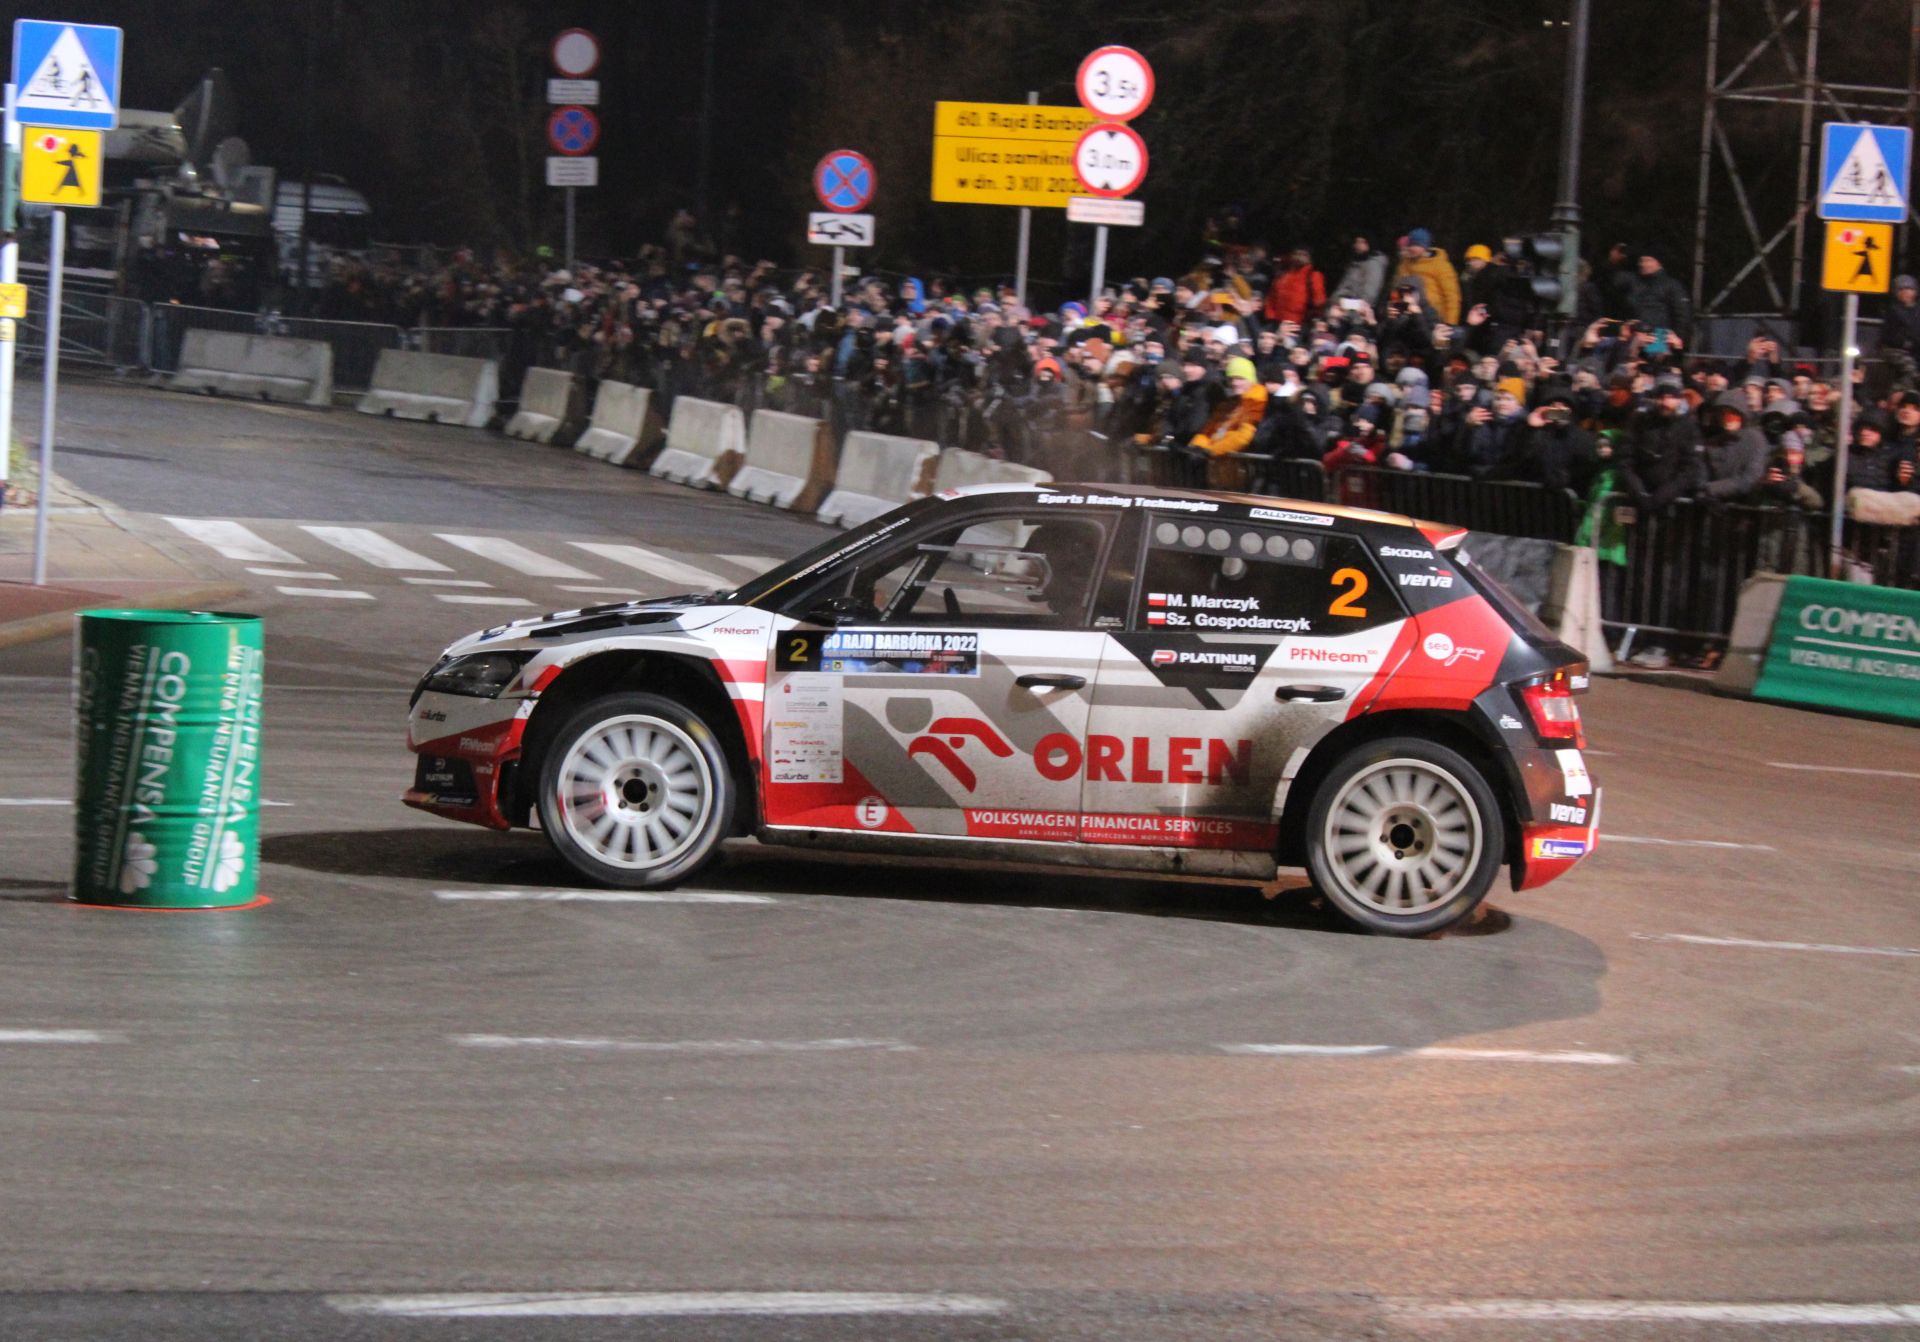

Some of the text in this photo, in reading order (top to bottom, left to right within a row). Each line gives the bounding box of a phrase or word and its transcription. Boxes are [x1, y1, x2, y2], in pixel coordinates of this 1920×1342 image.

[988, 111, 1028, 132] Rajd
[955, 147, 999, 164] Ulica
[1005, 175, 1016, 191] 3
[1048, 177, 1092, 194] 202
[1037, 493, 1220, 512] Sports Racing Technologies
[1380, 546, 1434, 560] ŠKODA
[1399, 573, 1454, 588] verva
[1167, 594, 1260, 611] M. Marczyk
[1328, 567, 1369, 618] 2
[1166, 612, 1311, 632] Sz. Gospodarczyk
[789, 638, 808, 662] 2
[842, 634, 873, 650] RAJD
[875, 632, 942, 650] BARBÓRKA
[944, 635, 977, 651] 2022
[1290, 647, 1368, 664] PFNteam
[1180, 652, 1257, 666] PLATINUM
[130, 651, 191, 823] COMPENSA
[225, 649, 263, 824] COMPENSA
[198, 715, 234, 818] INSURANCE
[1033, 732, 1254, 786] ORLEN
[972, 811, 1233, 834] VOLKSWAGEN FINANCIAL SERVICES
[182, 823, 211, 886] GROUP
